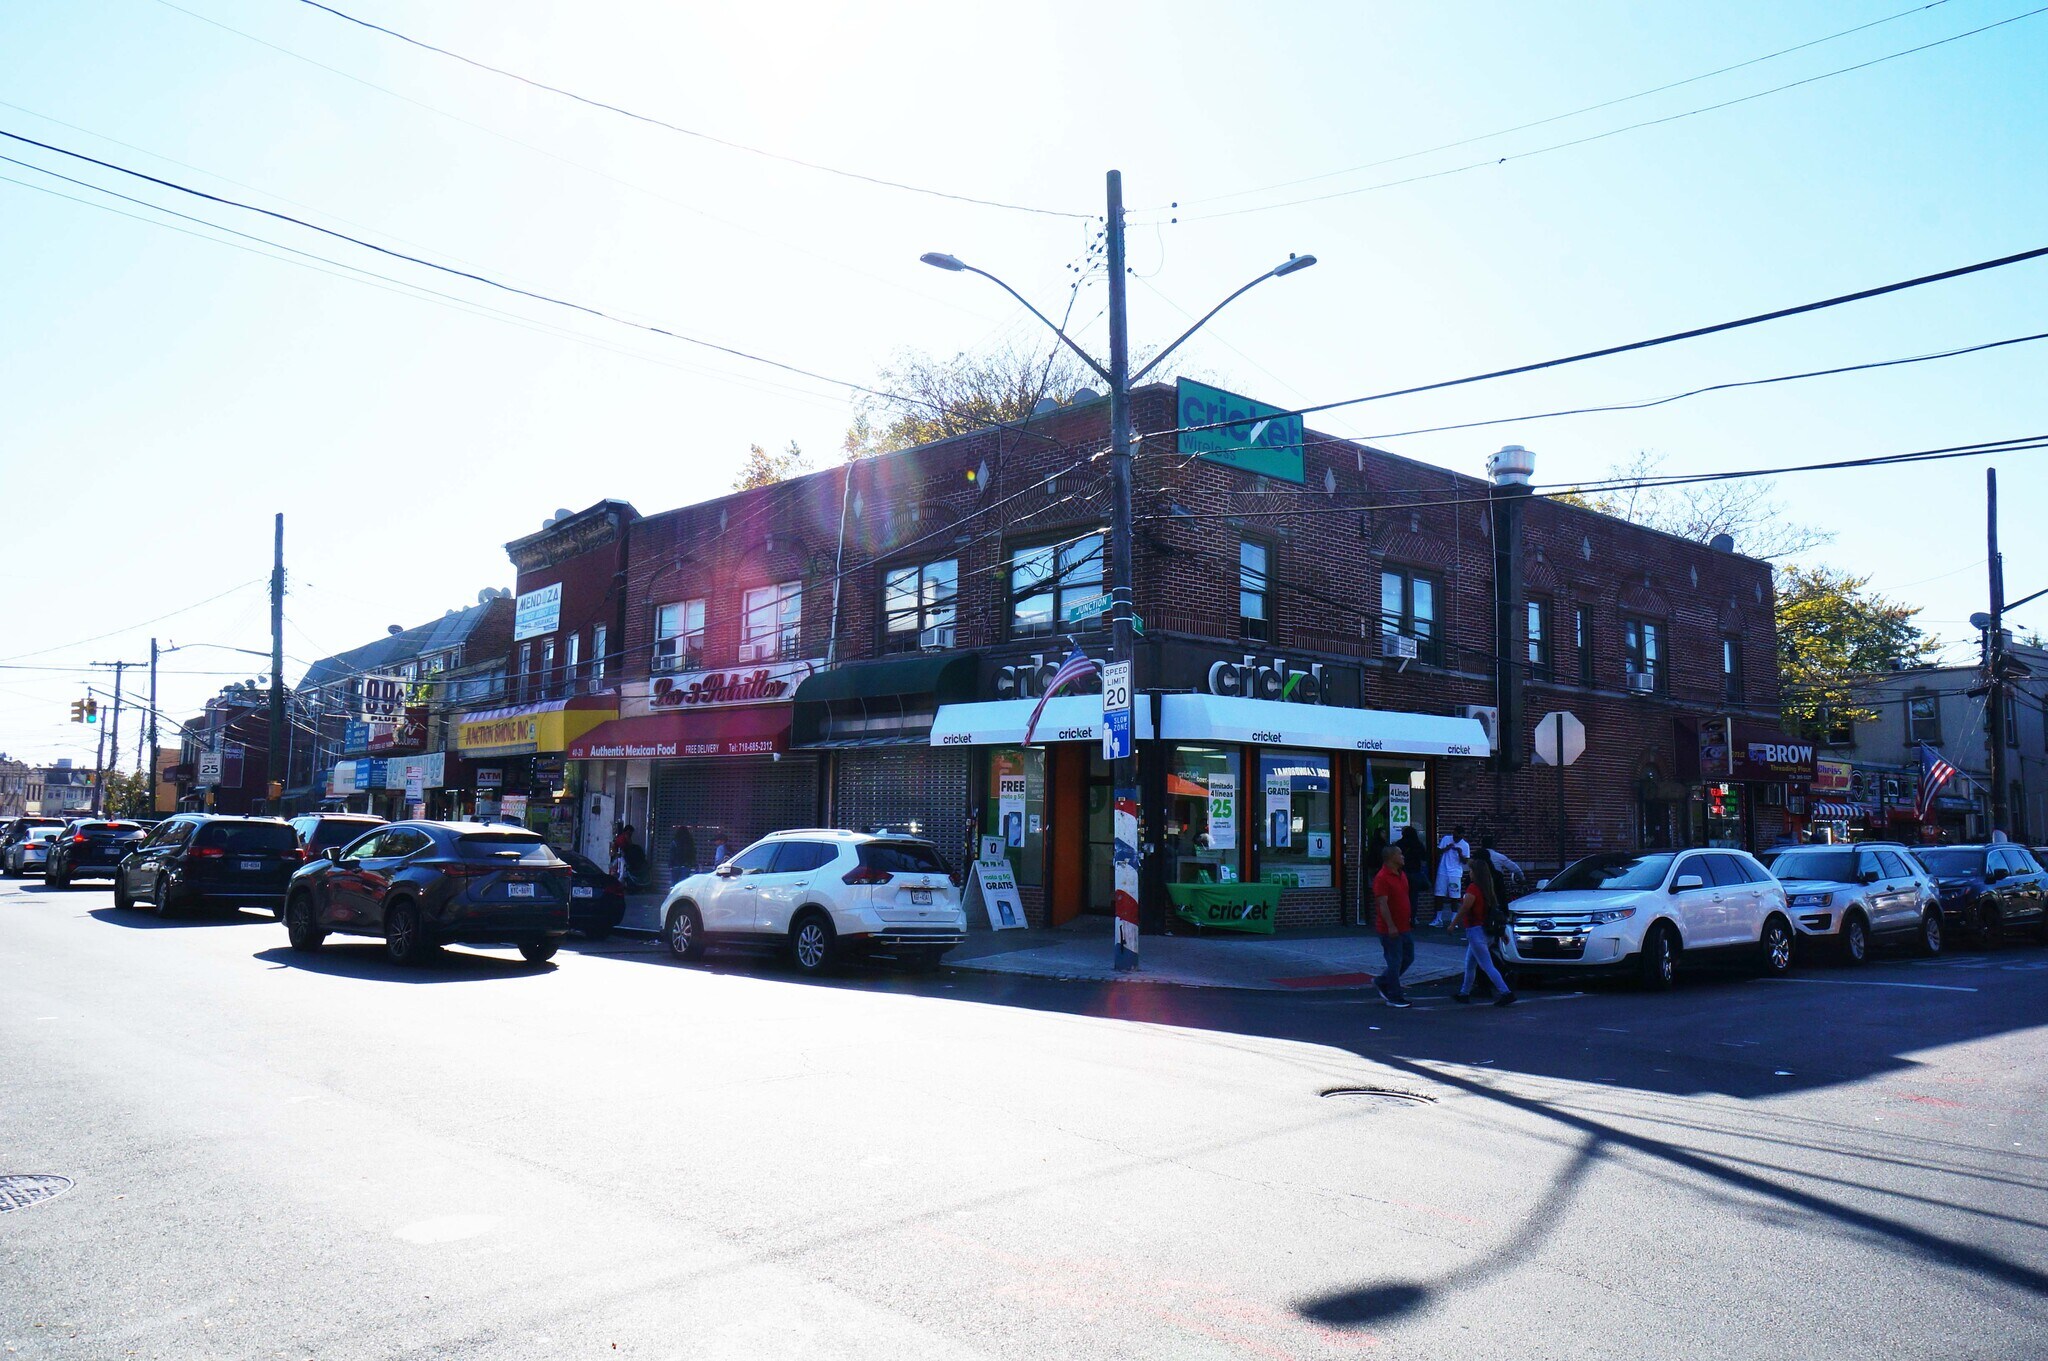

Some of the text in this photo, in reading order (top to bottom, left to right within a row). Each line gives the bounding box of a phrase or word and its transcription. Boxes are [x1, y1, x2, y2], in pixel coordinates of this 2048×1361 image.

[519, 587, 559, 611] MENDZA
[1076, 597, 1107, 615] JUNCTION
[1105, 666, 1128, 676] SPEED
[1107, 677, 1126, 687] LIMIT
[1209, 655, 1332, 704] cricket
[1106, 687, 1127, 706] 20
[1114, 716, 1128, 724] SLOW
[1114, 723, 1128, 731] ZONE
[943, 733, 972, 744] cricket
[1059, 727, 1092, 739] cricket
[1252, 731, 1281, 743] cricket
[590, 745, 625, 757] Authentic
[626, 745, 656, 756] Mexican
[657, 743, 677, 755] Food
[685, 745, 698, 754] FREE
[698, 743, 720, 754] DELIVERY
[1357, 739, 1383, 750] cricket
[1447, 745, 1471, 755] cricket
[1766, 744, 1813, 764] BROW
[202, 765, 219, 774] 25
[479, 772, 501, 780] ATM
[1001, 780, 1025, 792] FREE
[1267, 787, 1290, 795] GRATIS
[1390, 788, 1410, 798] 4 Lines
[985, 881, 1014, 890] GRATIS
[1208, 900, 1270, 920] cricket
